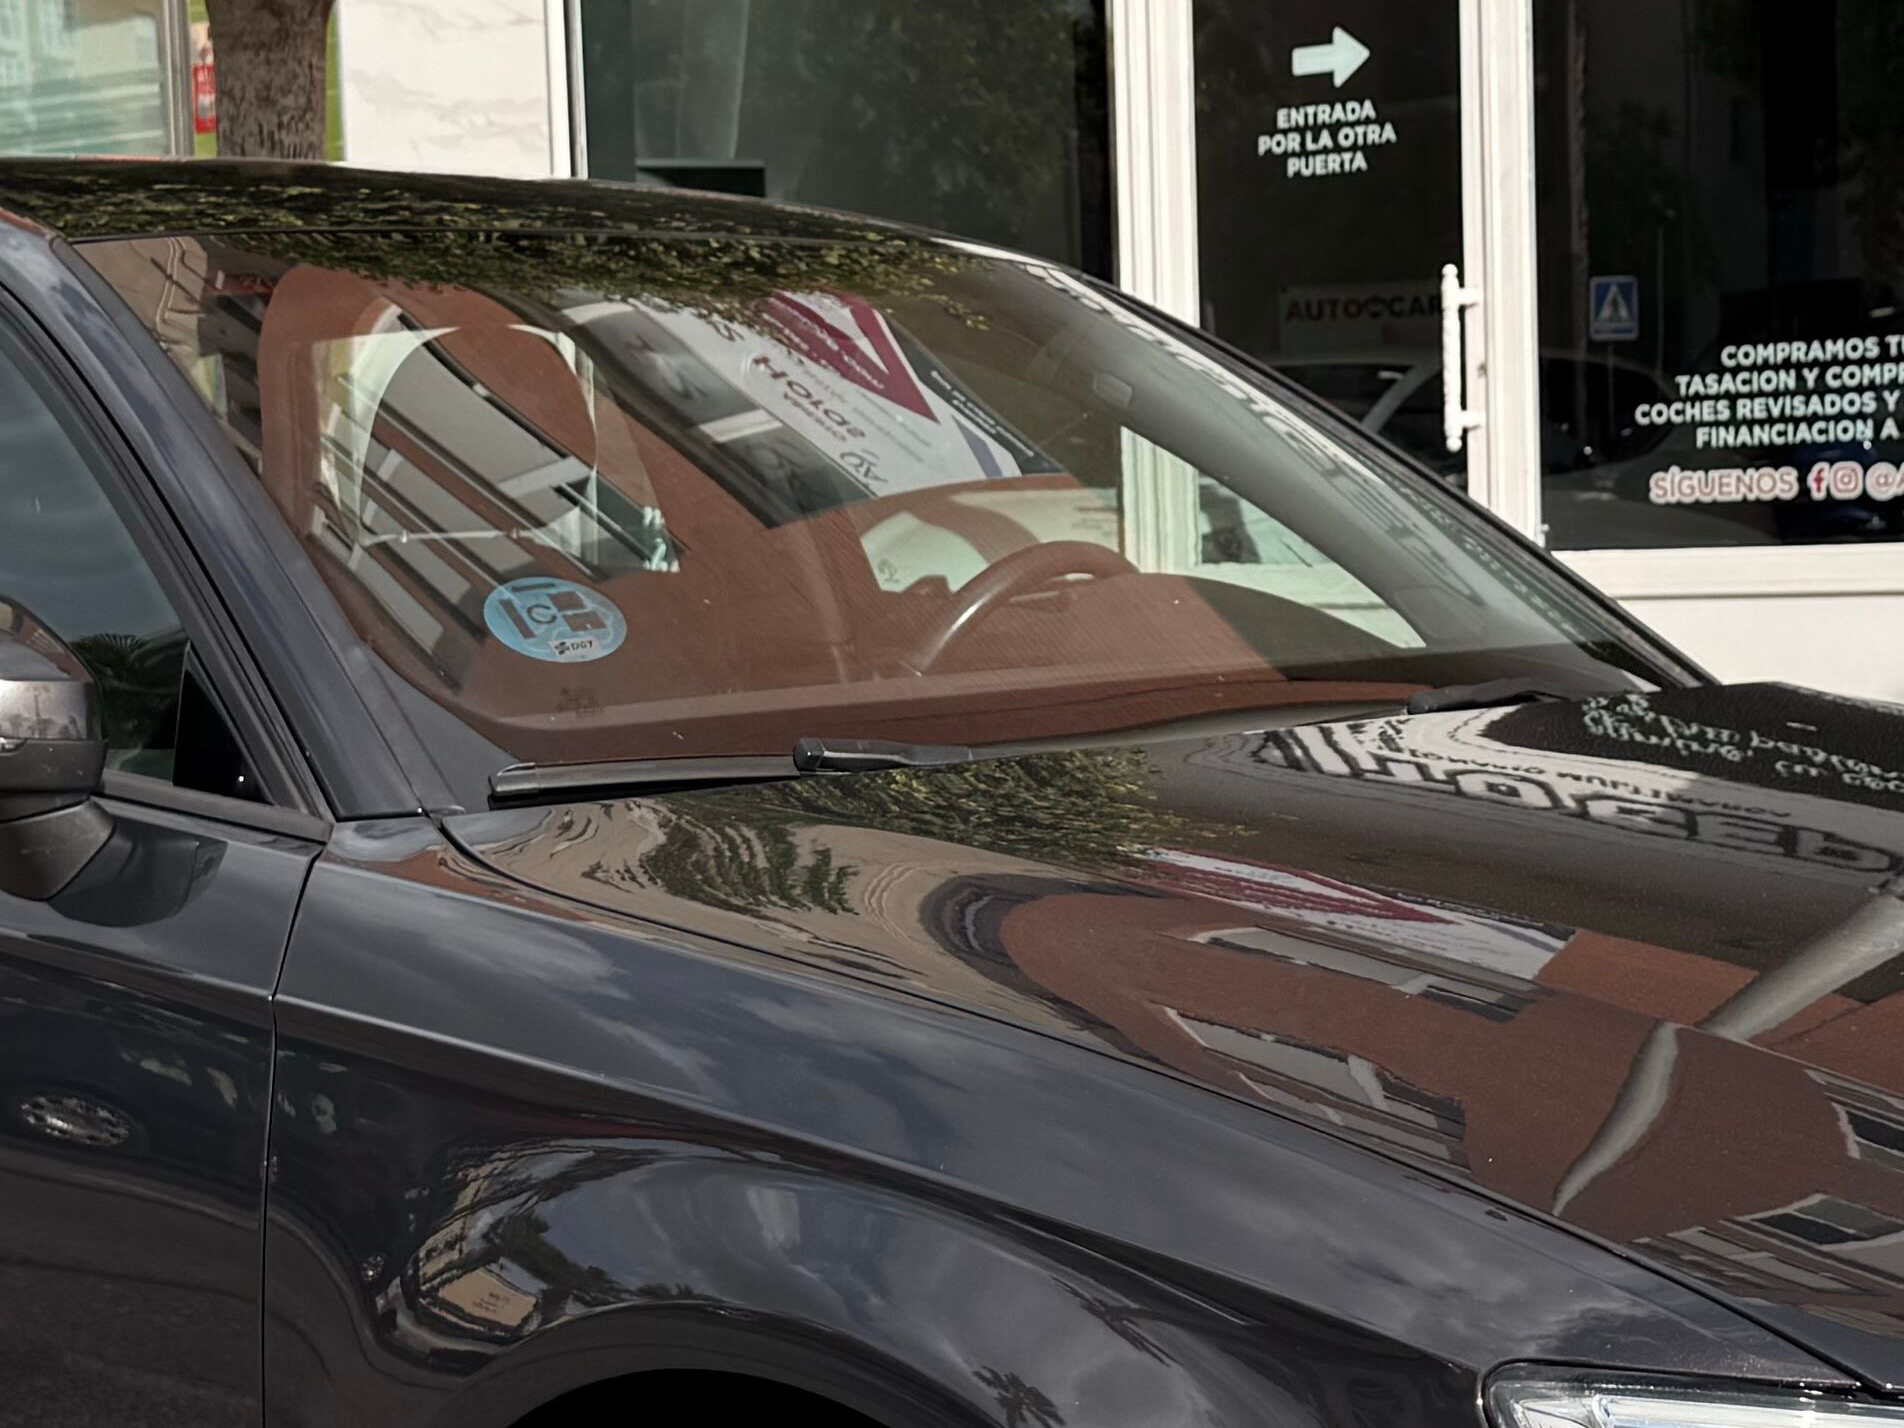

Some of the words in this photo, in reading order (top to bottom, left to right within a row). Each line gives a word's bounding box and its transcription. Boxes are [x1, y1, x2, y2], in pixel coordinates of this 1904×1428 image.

[1276, 98, 1377, 130] ENTRADA
[1257, 131, 1301, 157] POR
[1305, 128, 1334, 151] LA
[1337, 121, 1397, 148] OTRA
[1286, 150, 1368, 178] PUERTA
[1720, 336, 1880, 368] COMPRAMOS
[1675, 368, 1796, 397] TASACION
[1803, 366, 1819, 388] Y
[1634, 398, 1730, 426] COCHES
[1736, 389, 1877, 420] REVISADOS
[1883, 389, 1899, 411] Y
[1695, 418, 1874, 449] FINANCIACION
[1880, 415, 1898, 439] A
[1650, 467, 1797, 502] SÍGUENOS
